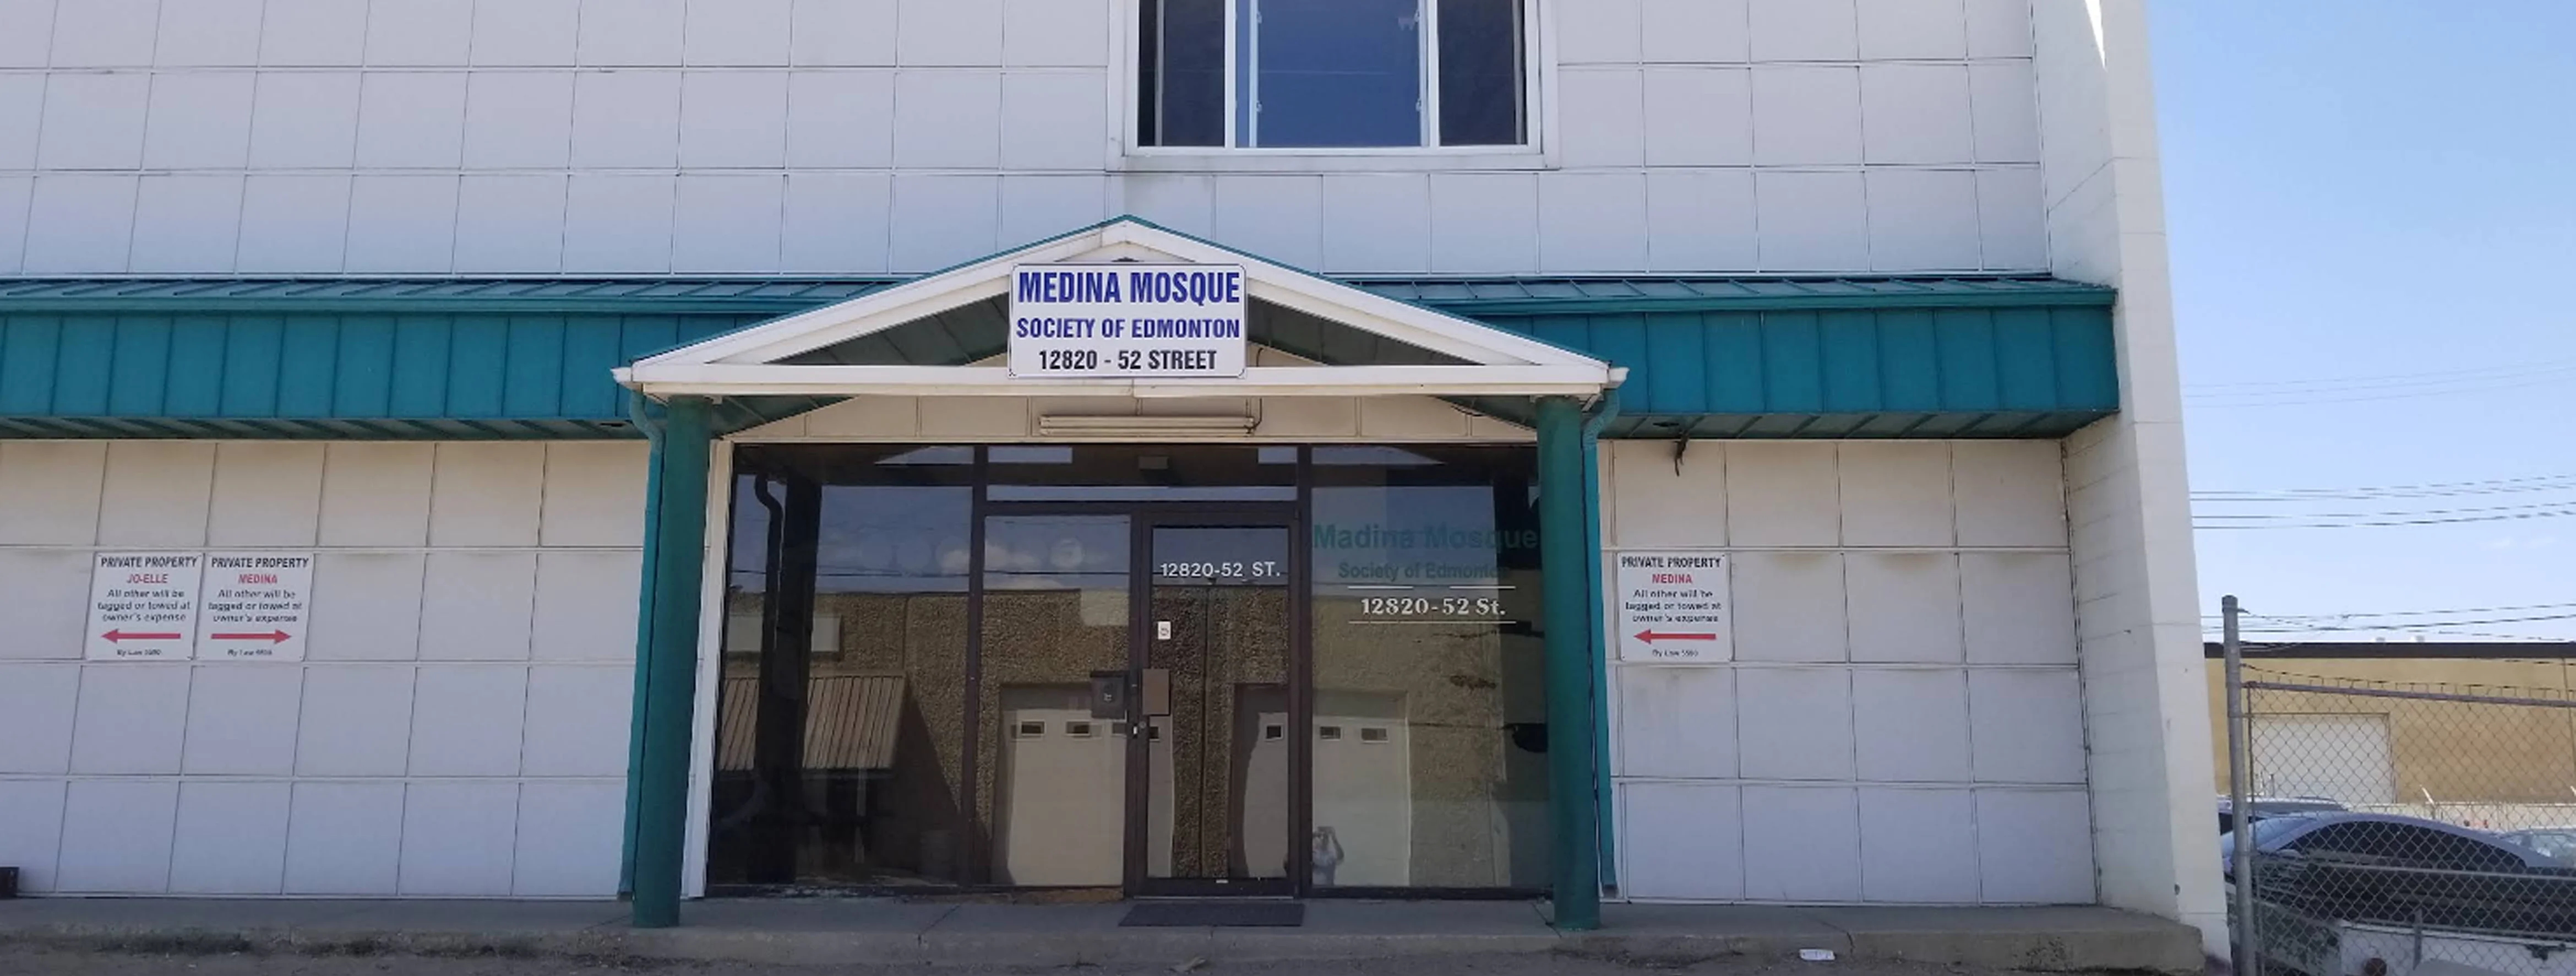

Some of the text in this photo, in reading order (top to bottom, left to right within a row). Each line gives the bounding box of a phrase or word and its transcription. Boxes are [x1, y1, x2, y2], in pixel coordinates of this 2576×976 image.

[1018, 272, 1240, 306] MEDINA MOSQUE
[1016, 318, 1240, 338] SOCIETY OF EDMONTON
[1039, 350, 1097, 369] 12820
[1118, 350, 1141, 369] 52
[1148, 350, 1217, 369] STREET
[1314, 524, 1538, 555] Madina Mosque
[101, 556, 198, 567] PRIVATE PROPERTY
[211, 557, 309, 567] PRIVATE PROPERTY
[1622, 556, 1721, 568] PRIVATE PROPERTY
[1160, 561, 1281, 577] 12820-52 ST.
[1339, 562, 1510, 581] Society of Edmonton
[127, 574, 168, 583] JO-ELLE
[238, 574, 277, 583] MEDINA
[1652, 573, 1692, 583] MEDINA
[219, 589, 296, 598] All other will be
[1633, 589, 1648, 598] All
[1650, 590, 1676, 598] other
[1680, 590, 1697, 598] will
[97, 601, 132, 611] tagged
[208, 602, 242, 611] tagged
[1475, 598, 1506, 615] St.
[1625, 602, 1660, 611] tagged
[144, 614, 186, 623] expense
